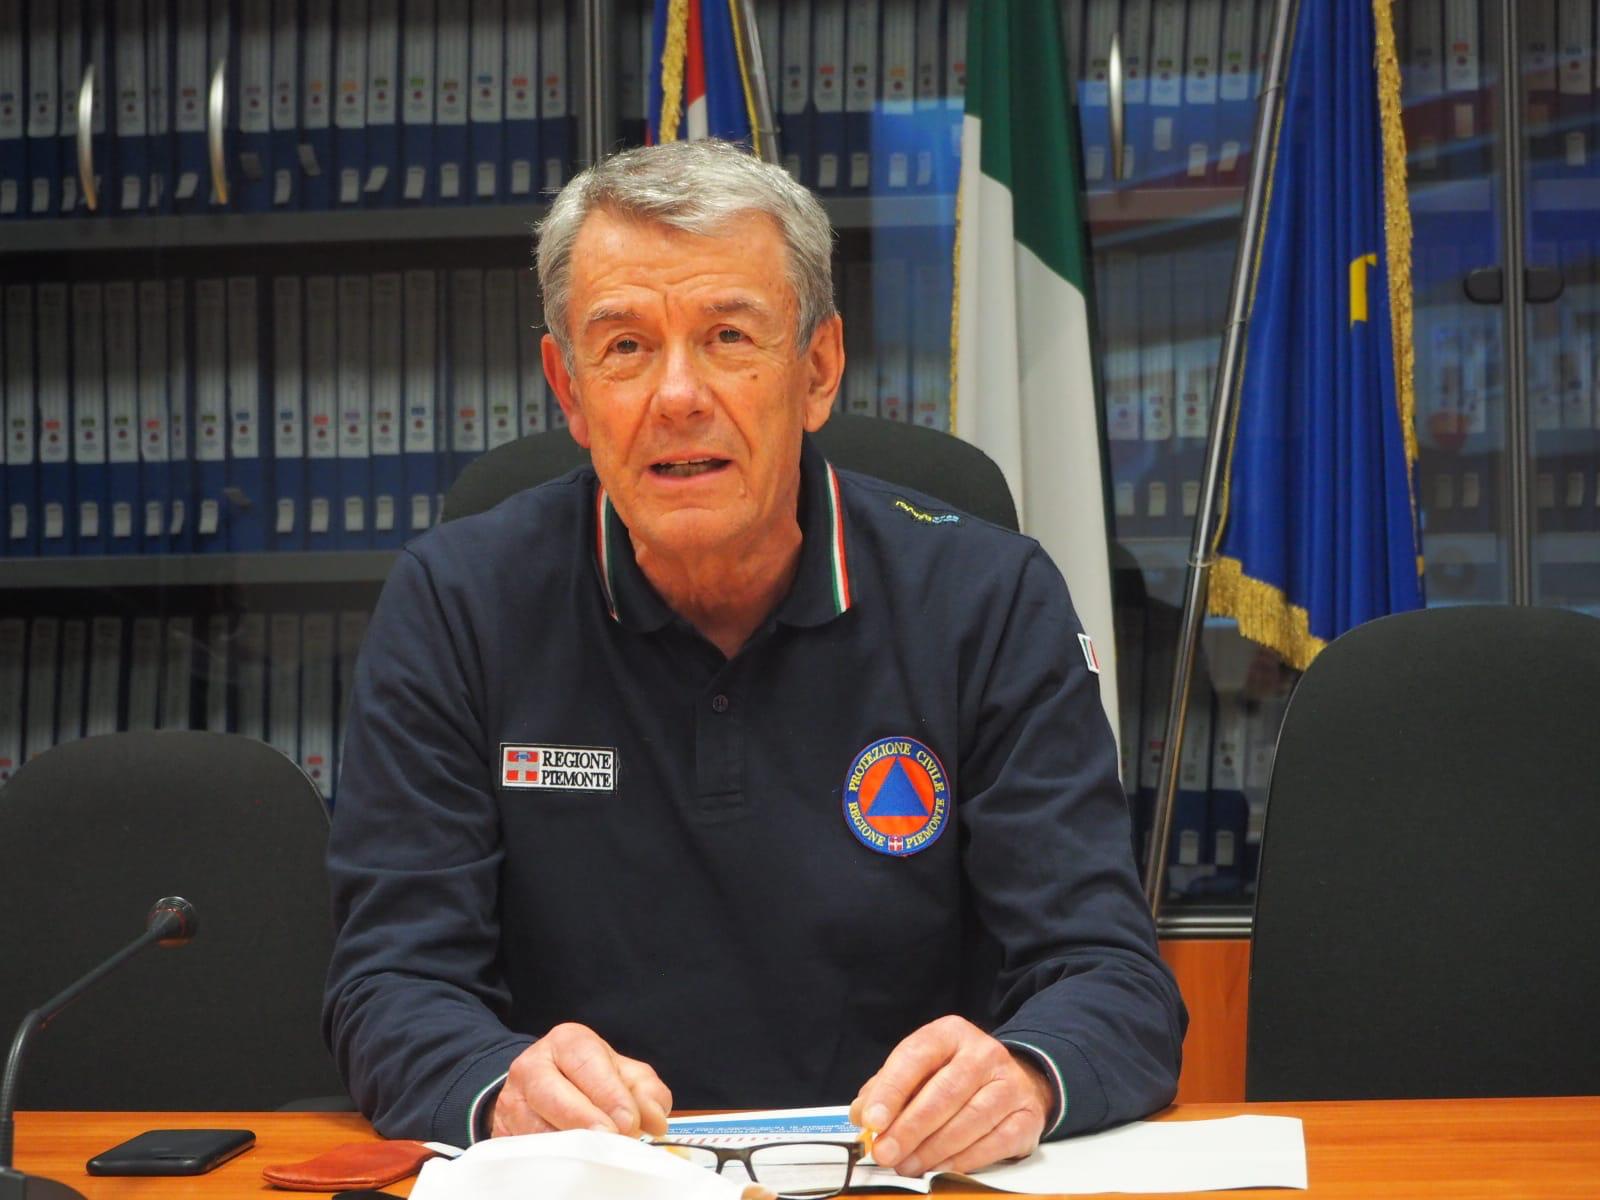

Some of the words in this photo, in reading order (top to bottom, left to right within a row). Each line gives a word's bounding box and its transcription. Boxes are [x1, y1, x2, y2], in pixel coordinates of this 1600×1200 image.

[541, 750, 612, 769] REGIONE
[848, 742, 912, 792] PROTEZIONE
[916, 750, 945, 792] CIVILE
[541, 770, 612, 787] PIEMONTE
[848, 801, 886, 846] REGIONE
[905, 798, 945, 848] PIEMONTE
